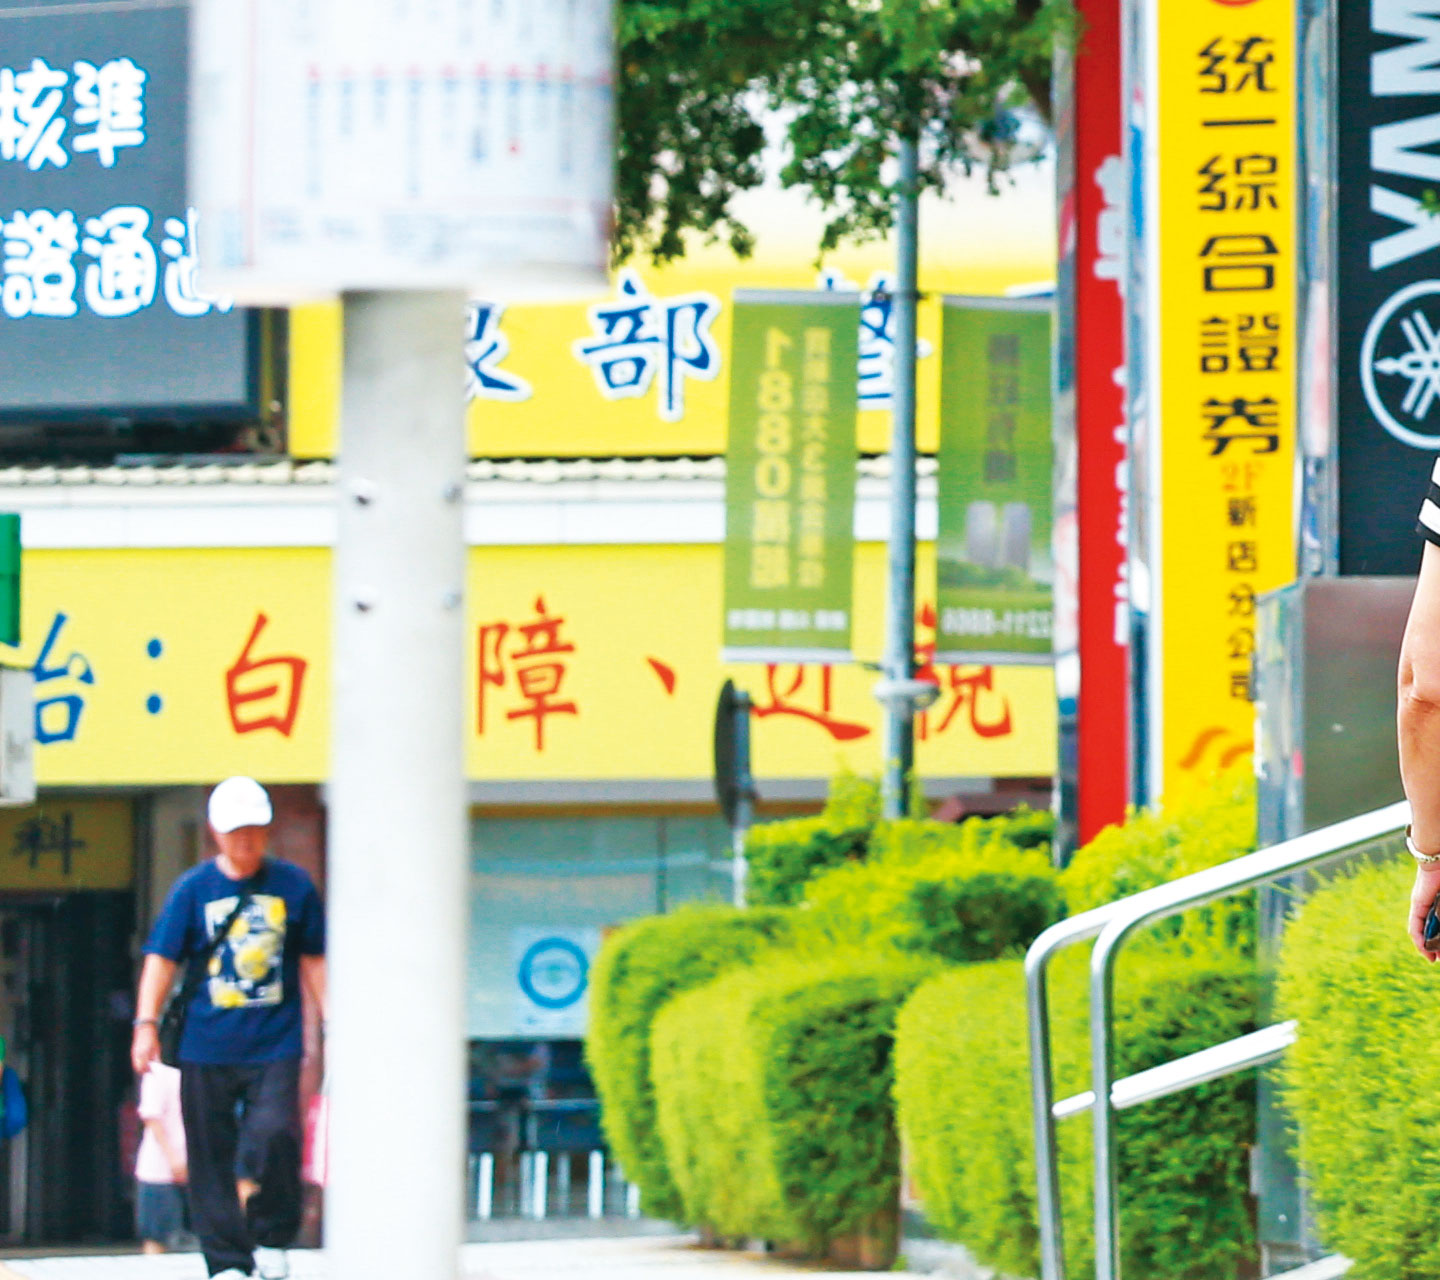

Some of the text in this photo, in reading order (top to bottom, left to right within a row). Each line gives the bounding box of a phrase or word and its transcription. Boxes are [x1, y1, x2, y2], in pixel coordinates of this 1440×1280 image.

[1197, 35, 1280, 458] 統一綜合證券
